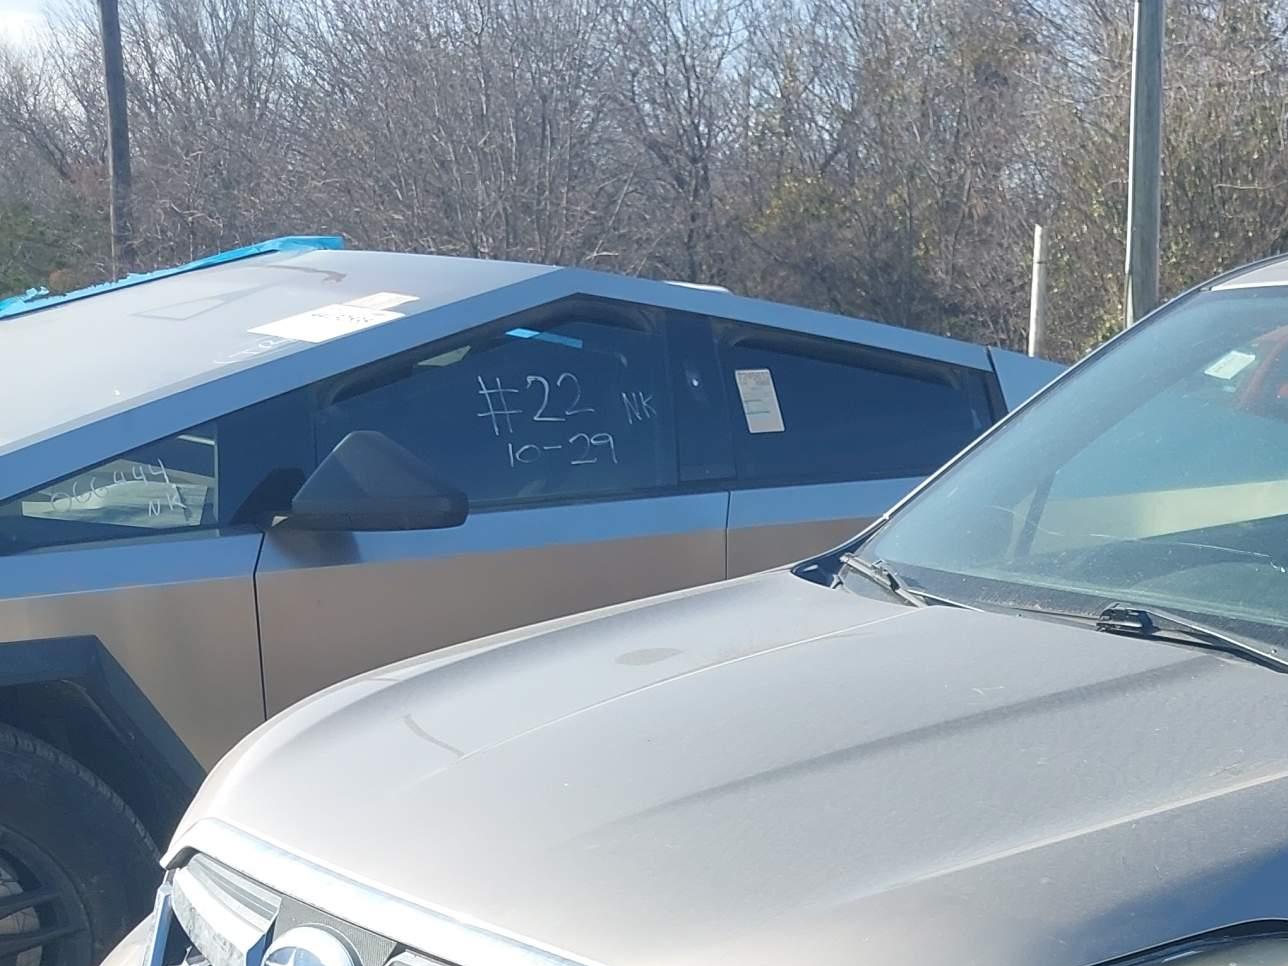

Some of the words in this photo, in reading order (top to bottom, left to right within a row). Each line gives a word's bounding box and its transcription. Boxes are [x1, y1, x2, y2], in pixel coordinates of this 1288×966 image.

[477, 373, 596, 436] #22
[621, 391, 658, 424] NK
[508, 432, 618, 467] 10-29
